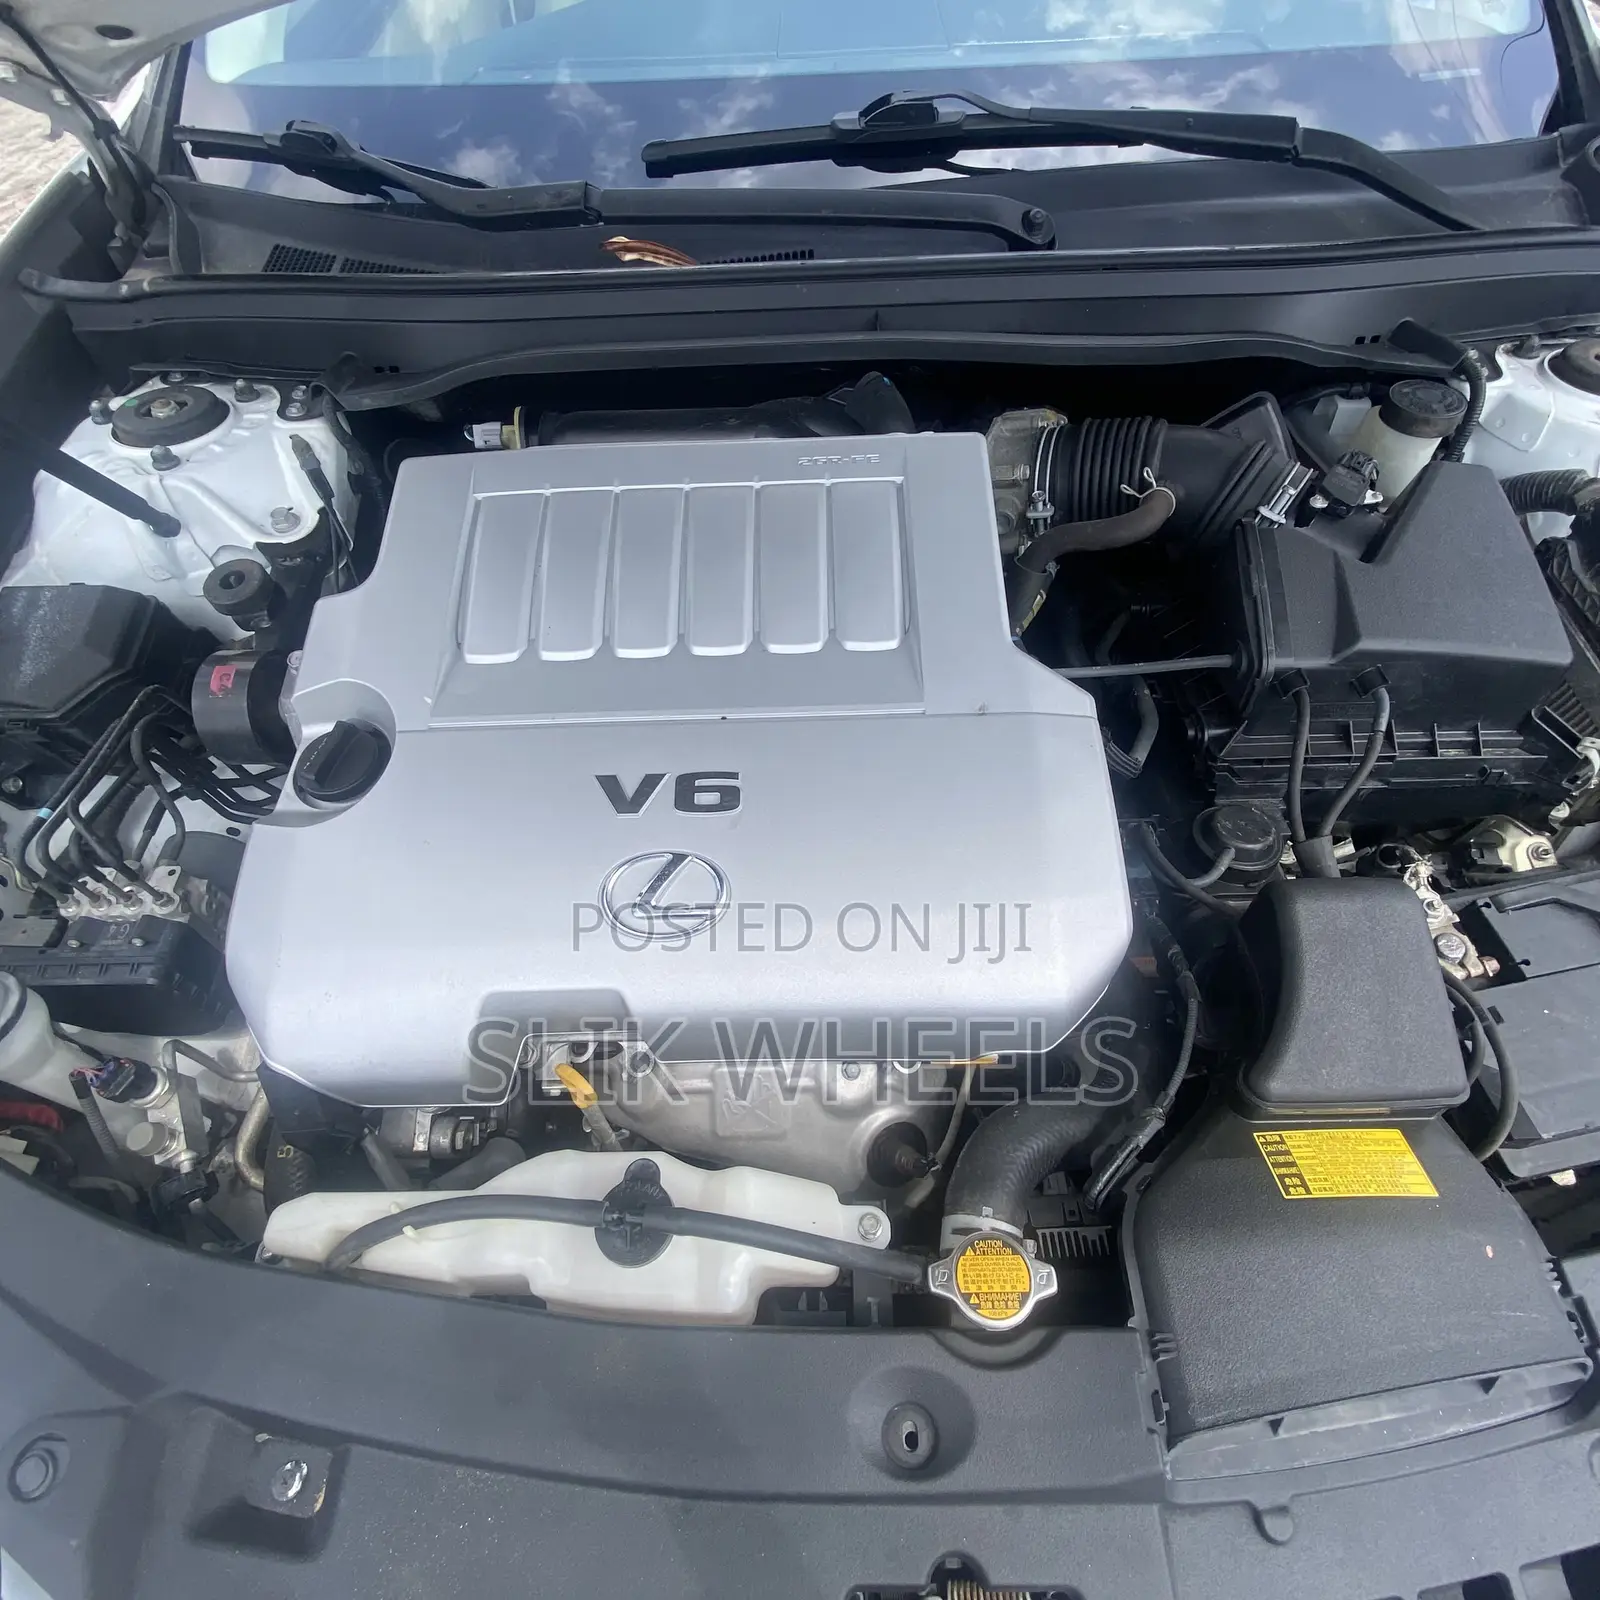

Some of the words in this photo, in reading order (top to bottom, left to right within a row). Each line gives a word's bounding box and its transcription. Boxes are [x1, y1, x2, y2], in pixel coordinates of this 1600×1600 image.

[595, 770, 743, 818] V6
[1262, 1144, 1290, 1152] CAUTION
[974, 1240, 1003, 1248] CAUTION
[975, 1247, 1013, 1255] ATTENTION
